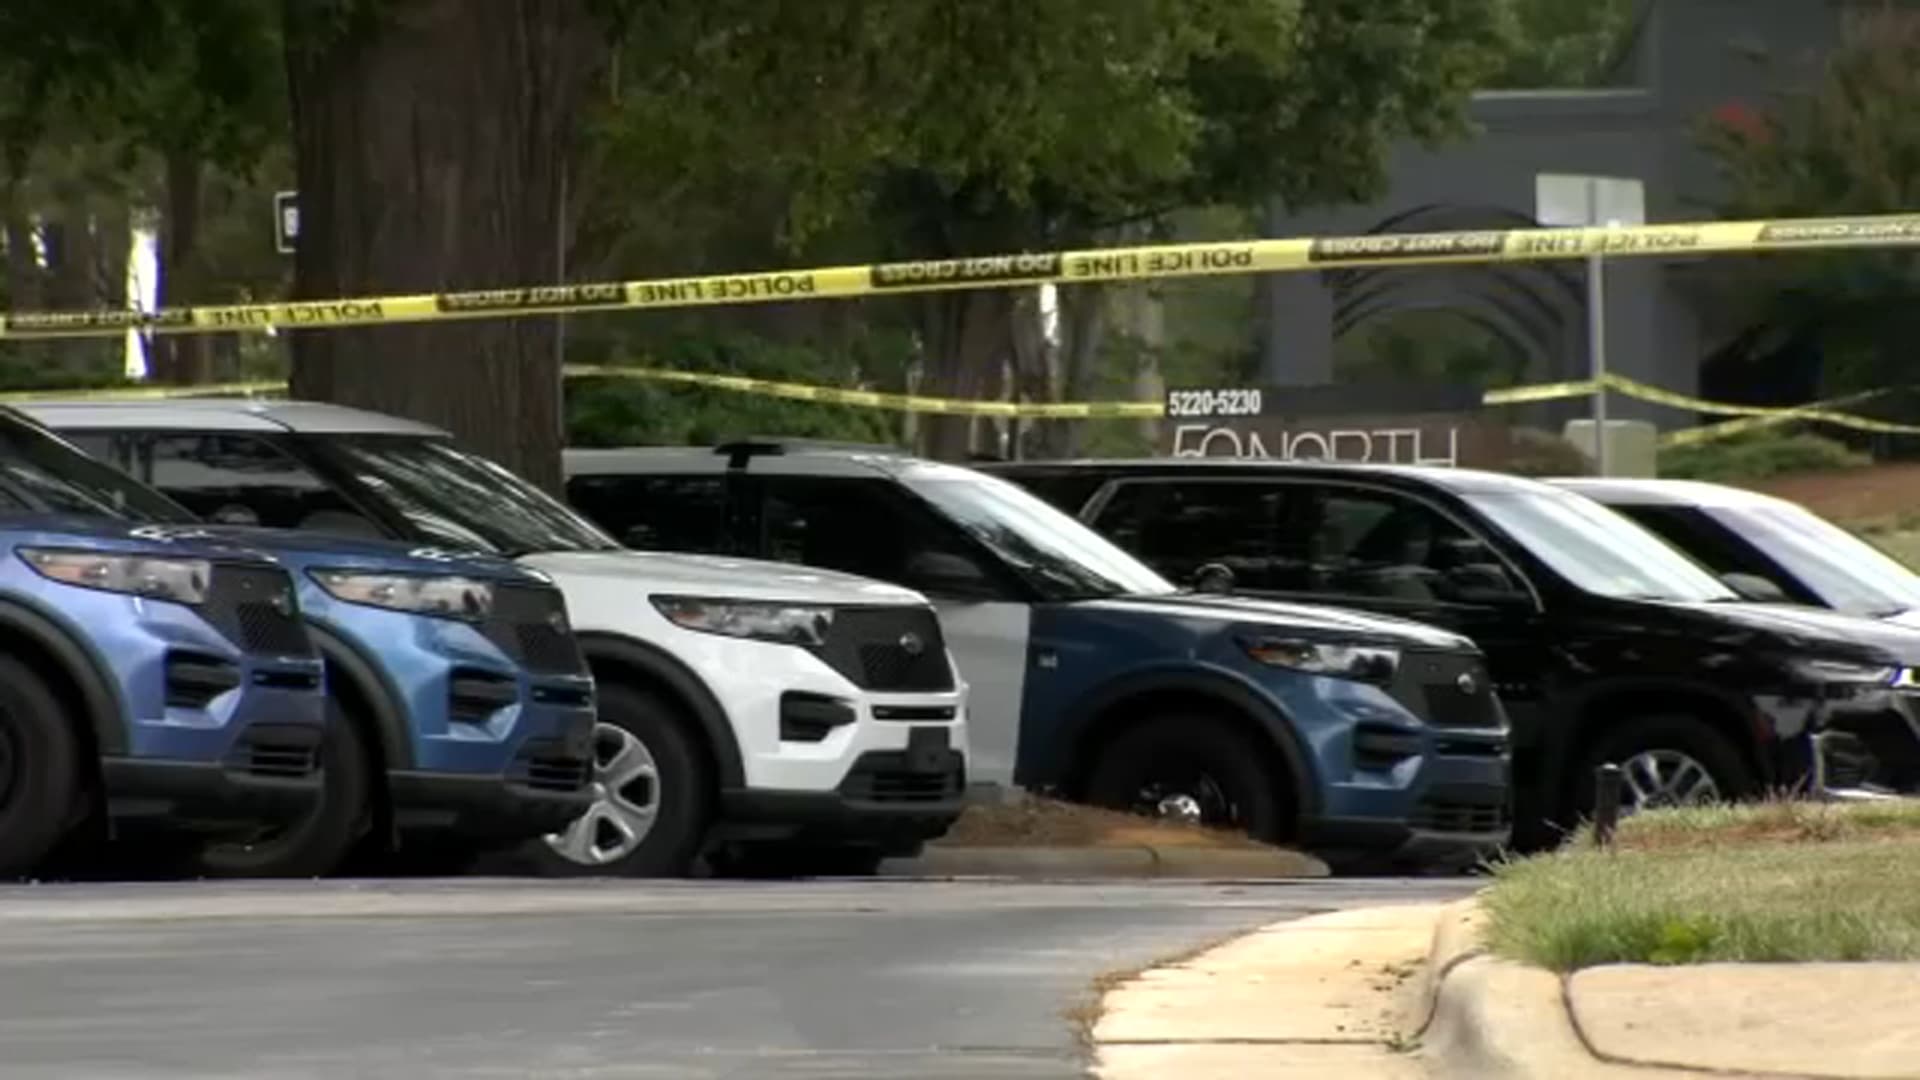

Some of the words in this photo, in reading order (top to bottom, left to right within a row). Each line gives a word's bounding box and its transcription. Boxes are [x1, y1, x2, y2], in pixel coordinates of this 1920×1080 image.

[879, 260, 955, 282] CROSS
[960, 255, 1011, 277] NOT
[1016, 252, 1056, 272] DO
[1072, 253, 1139, 277] LINE
[1149, 247, 1252, 272] POLICE
[637, 280, 702, 304] LINE
[709, 274, 815, 299] POLICE
[211, 308, 273, 326] LINE
[281, 302, 385, 324] POLICE
[1169, 389, 1262, 416] 5220-5230
